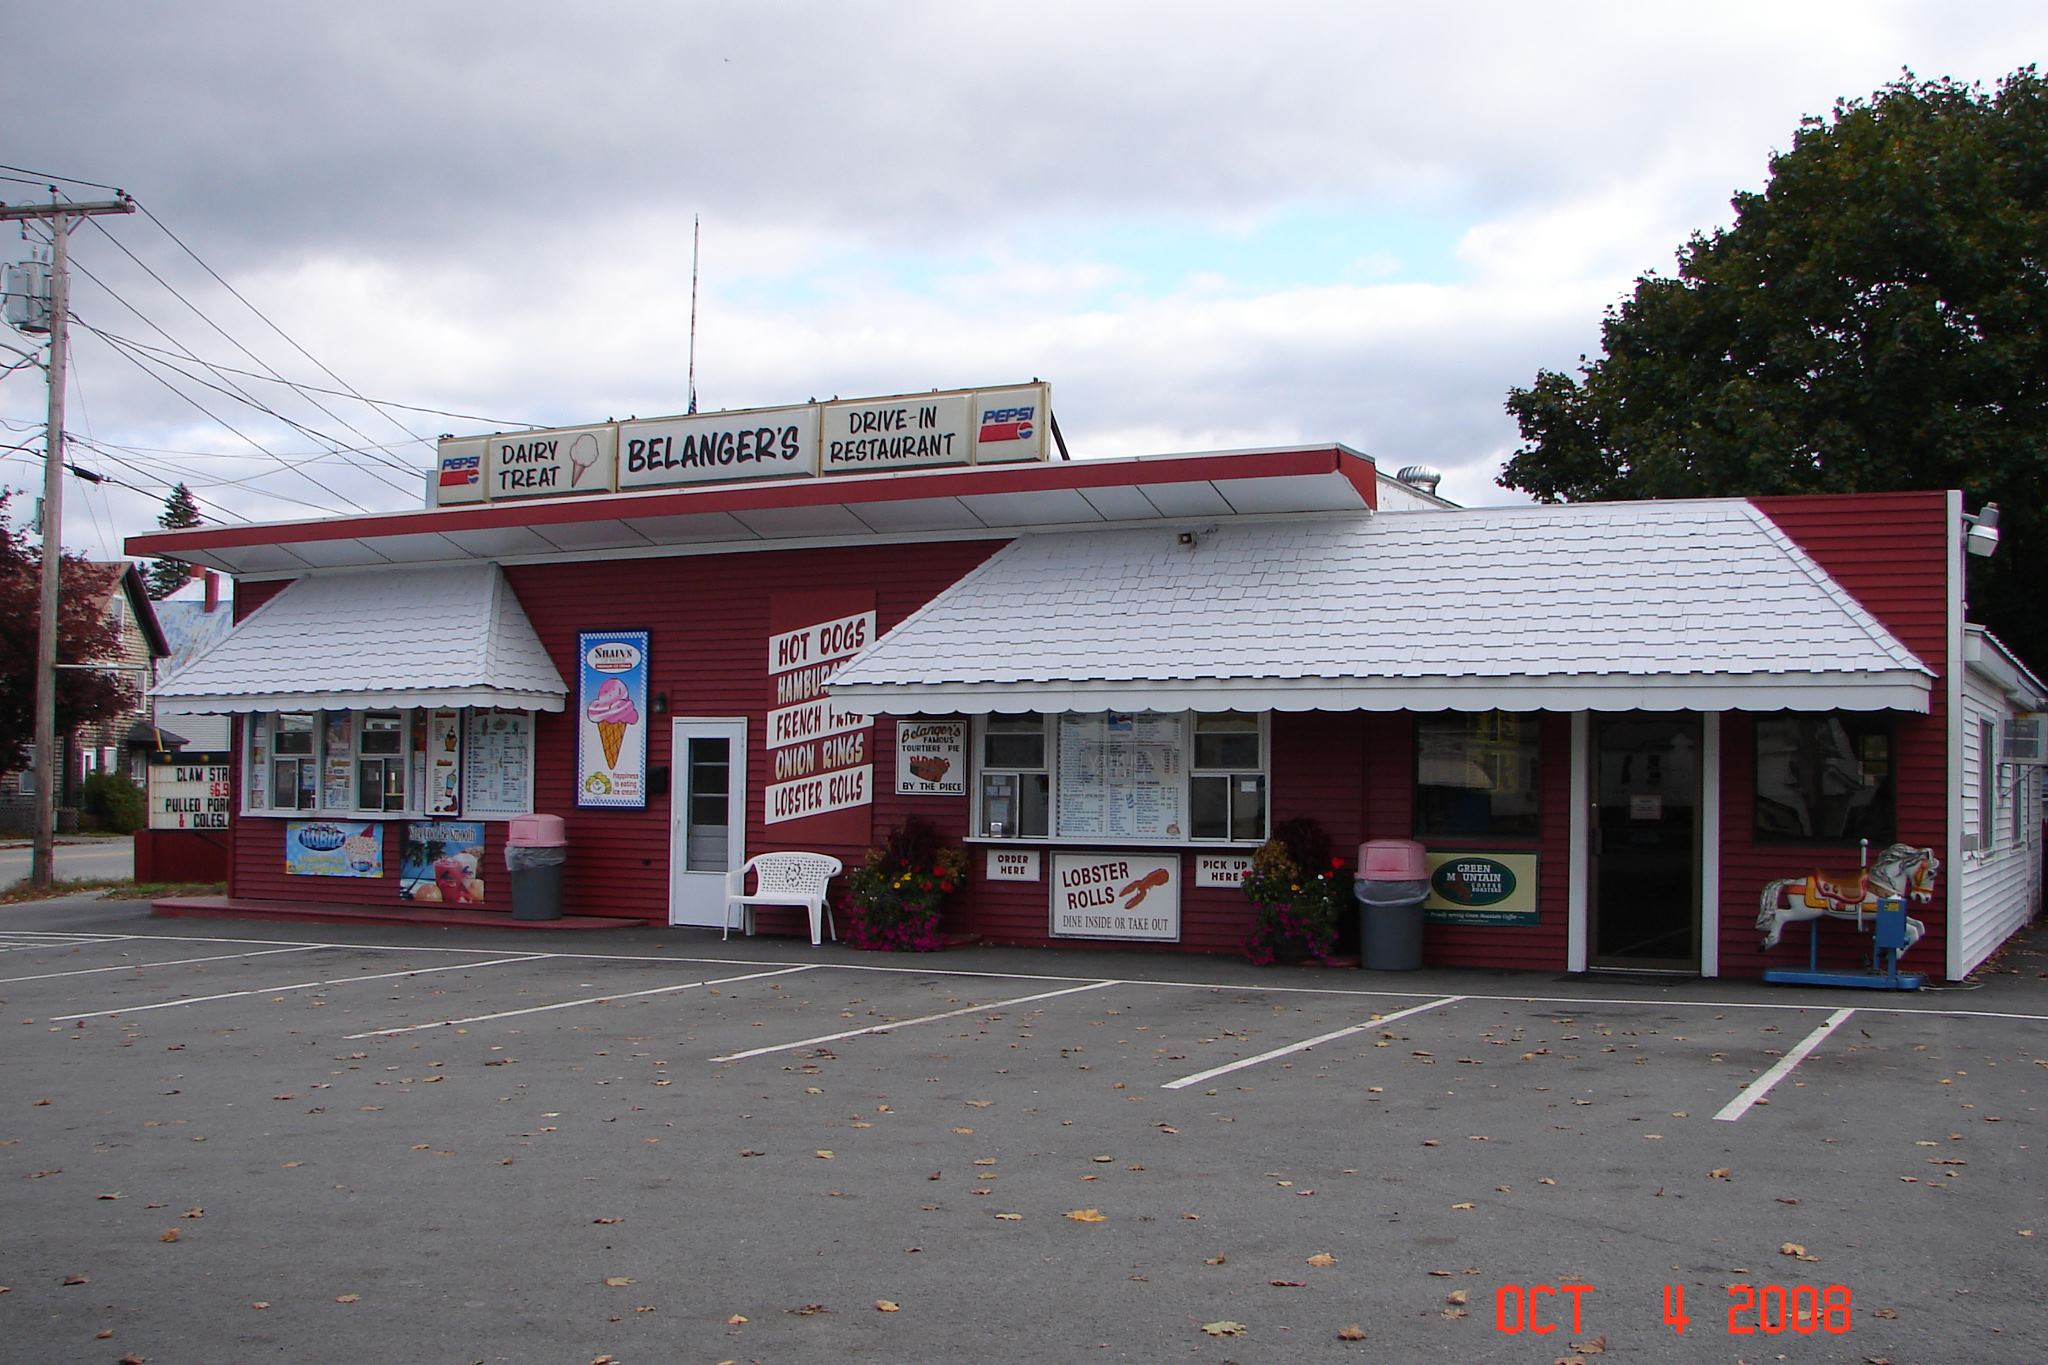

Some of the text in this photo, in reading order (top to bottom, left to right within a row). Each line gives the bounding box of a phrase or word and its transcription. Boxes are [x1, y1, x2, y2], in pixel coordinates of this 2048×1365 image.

[850, 406, 937, 434] DRIVE-IN
[982, 407, 1035, 424] PEPSI
[502, 441, 559, 464] DAIRY
[628, 426, 800, 473] BELANGER'S
[830, 433, 956, 463] RESTAURANT
[442, 456, 480, 471] PEPSI
[499, 466, 560, 490] TREAT
[778, 618, 865, 666] HOT DOGS
[778, 660, 846, 705] HAMBUR
[777, 705, 821, 740] FRENCH
[902, 724, 961, 744] Belanger's
[775, 732, 864, 780] ONION RINGS
[177, 767, 230, 782] CLAM STR
[775, 771, 863, 817] LOBSTER ROLLS
[902, 782, 961, 791] BY THE PIECE
[166, 798, 201, 812] PULLED
[179, 813, 228, 827] & COLESL
[998, 854, 1028, 864] ORDER
[1203, 860, 1247, 870] PICK UP
[1001, 866, 1026, 875] HERE
[1062, 861, 1129, 888] LOBSTER
[1212, 872, 1238, 881] HERE
[1446, 872, 1501, 882] MUNTAIN
[1457, 864, 1490, 873] GREEN
[1067, 886, 1115, 910] ROLLS
[1063, 915, 1169, 931] DINE INSIDE OR TAKE OUT
